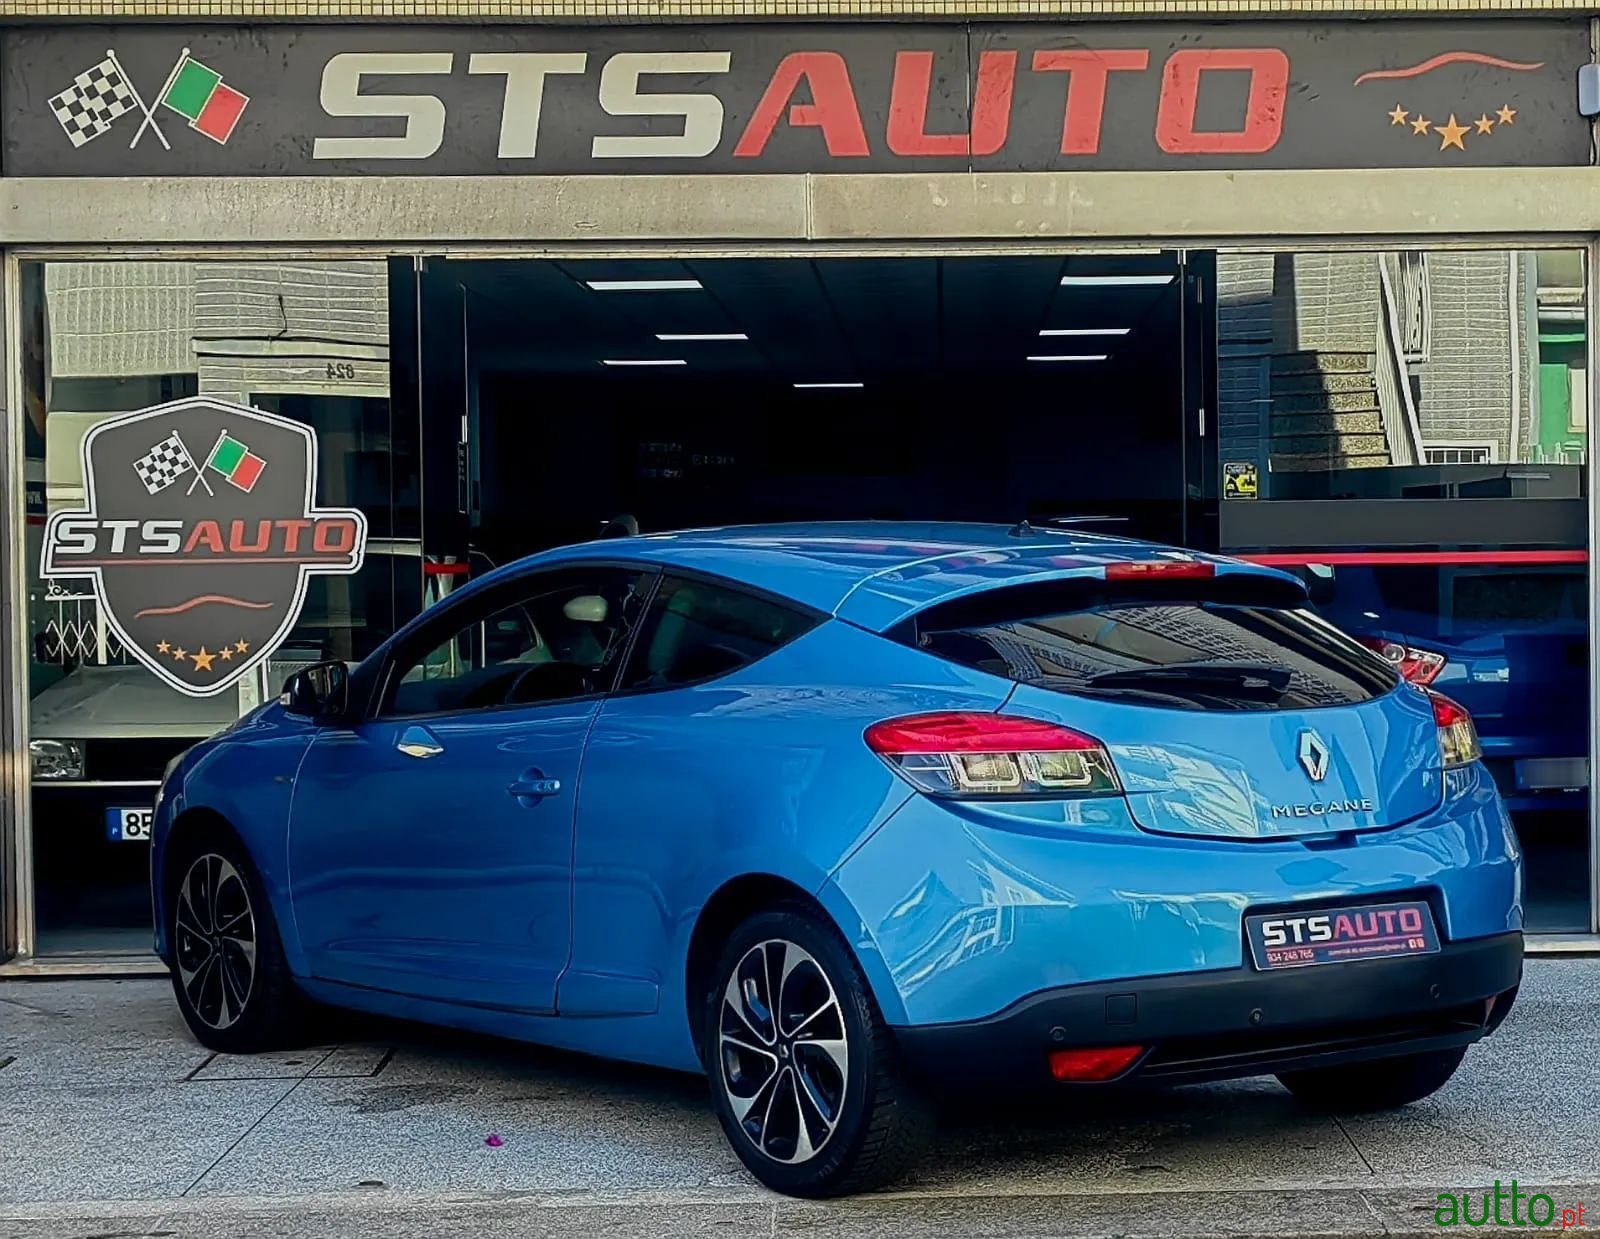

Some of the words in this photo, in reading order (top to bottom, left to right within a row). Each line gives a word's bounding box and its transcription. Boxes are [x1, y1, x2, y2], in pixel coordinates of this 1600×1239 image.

[312, 48, 1290, 160] STSAUTO
[55, 520, 357, 553] STSAUTO
[1271, 798, 1374, 818] MEGANE
[1262, 908, 1422, 946] STSAUTO
